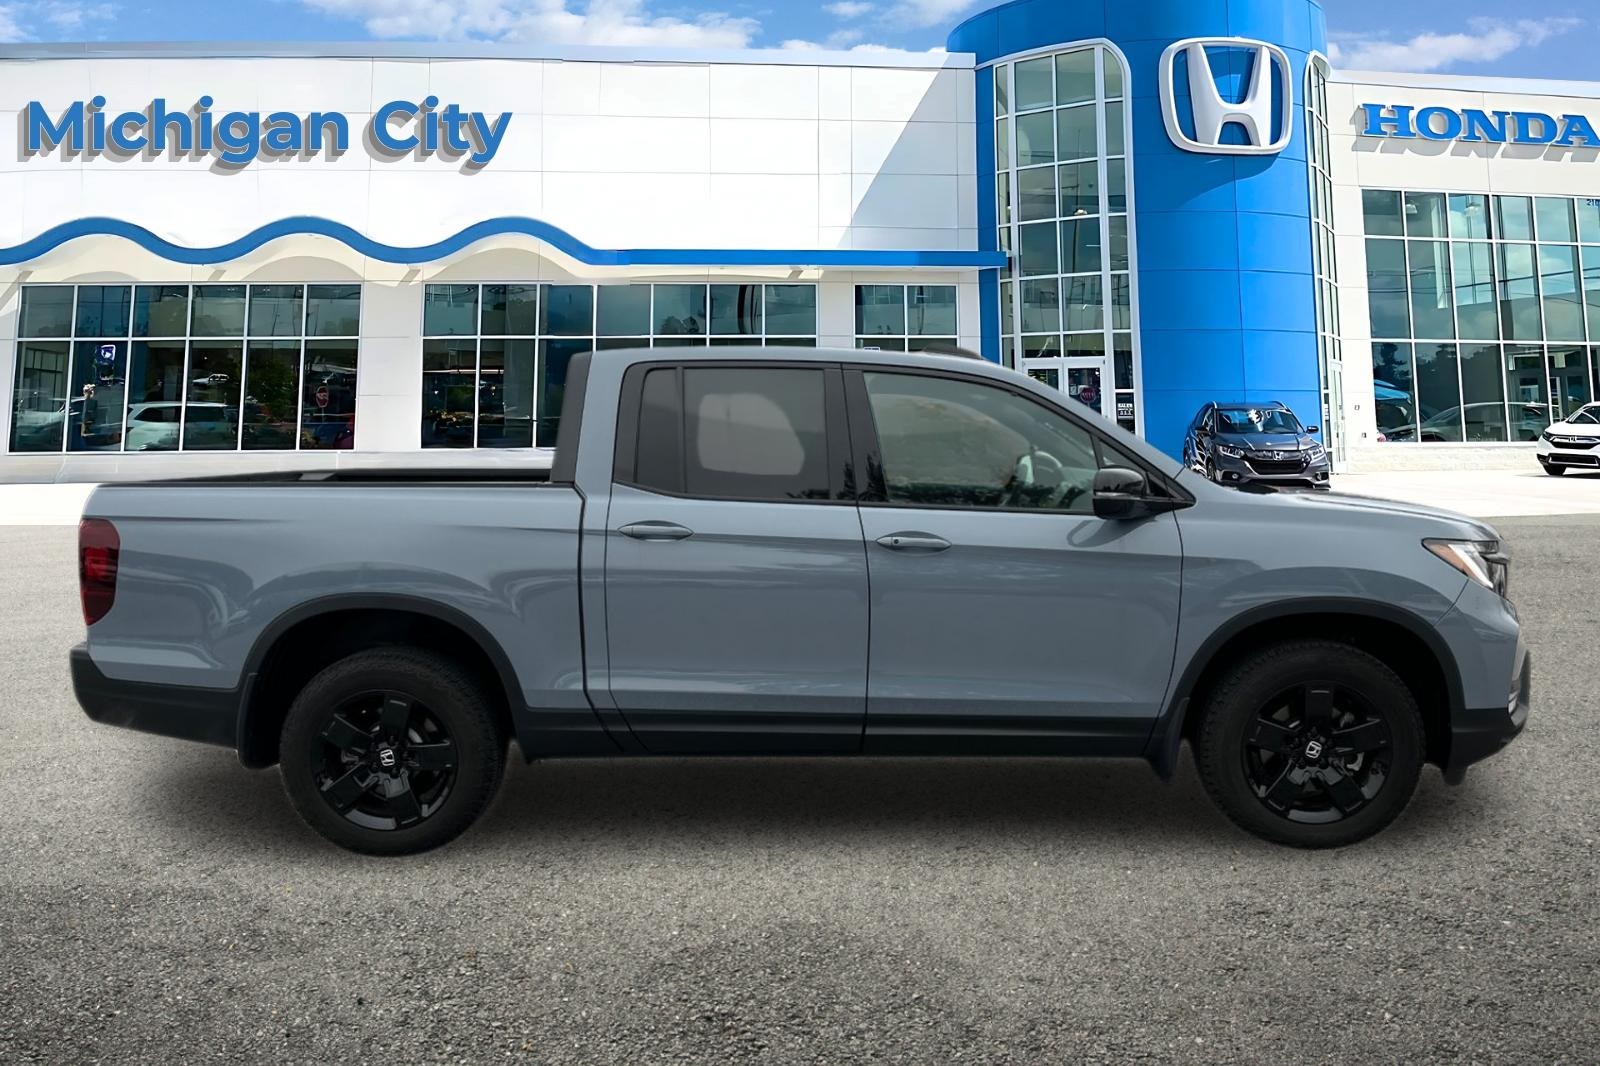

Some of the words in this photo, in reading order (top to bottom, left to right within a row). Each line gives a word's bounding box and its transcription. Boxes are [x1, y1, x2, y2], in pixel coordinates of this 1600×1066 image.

[28, 95, 349, 164] Michigan
[373, 95, 513, 164] City
[1361, 103, 1600, 147] HONDA
